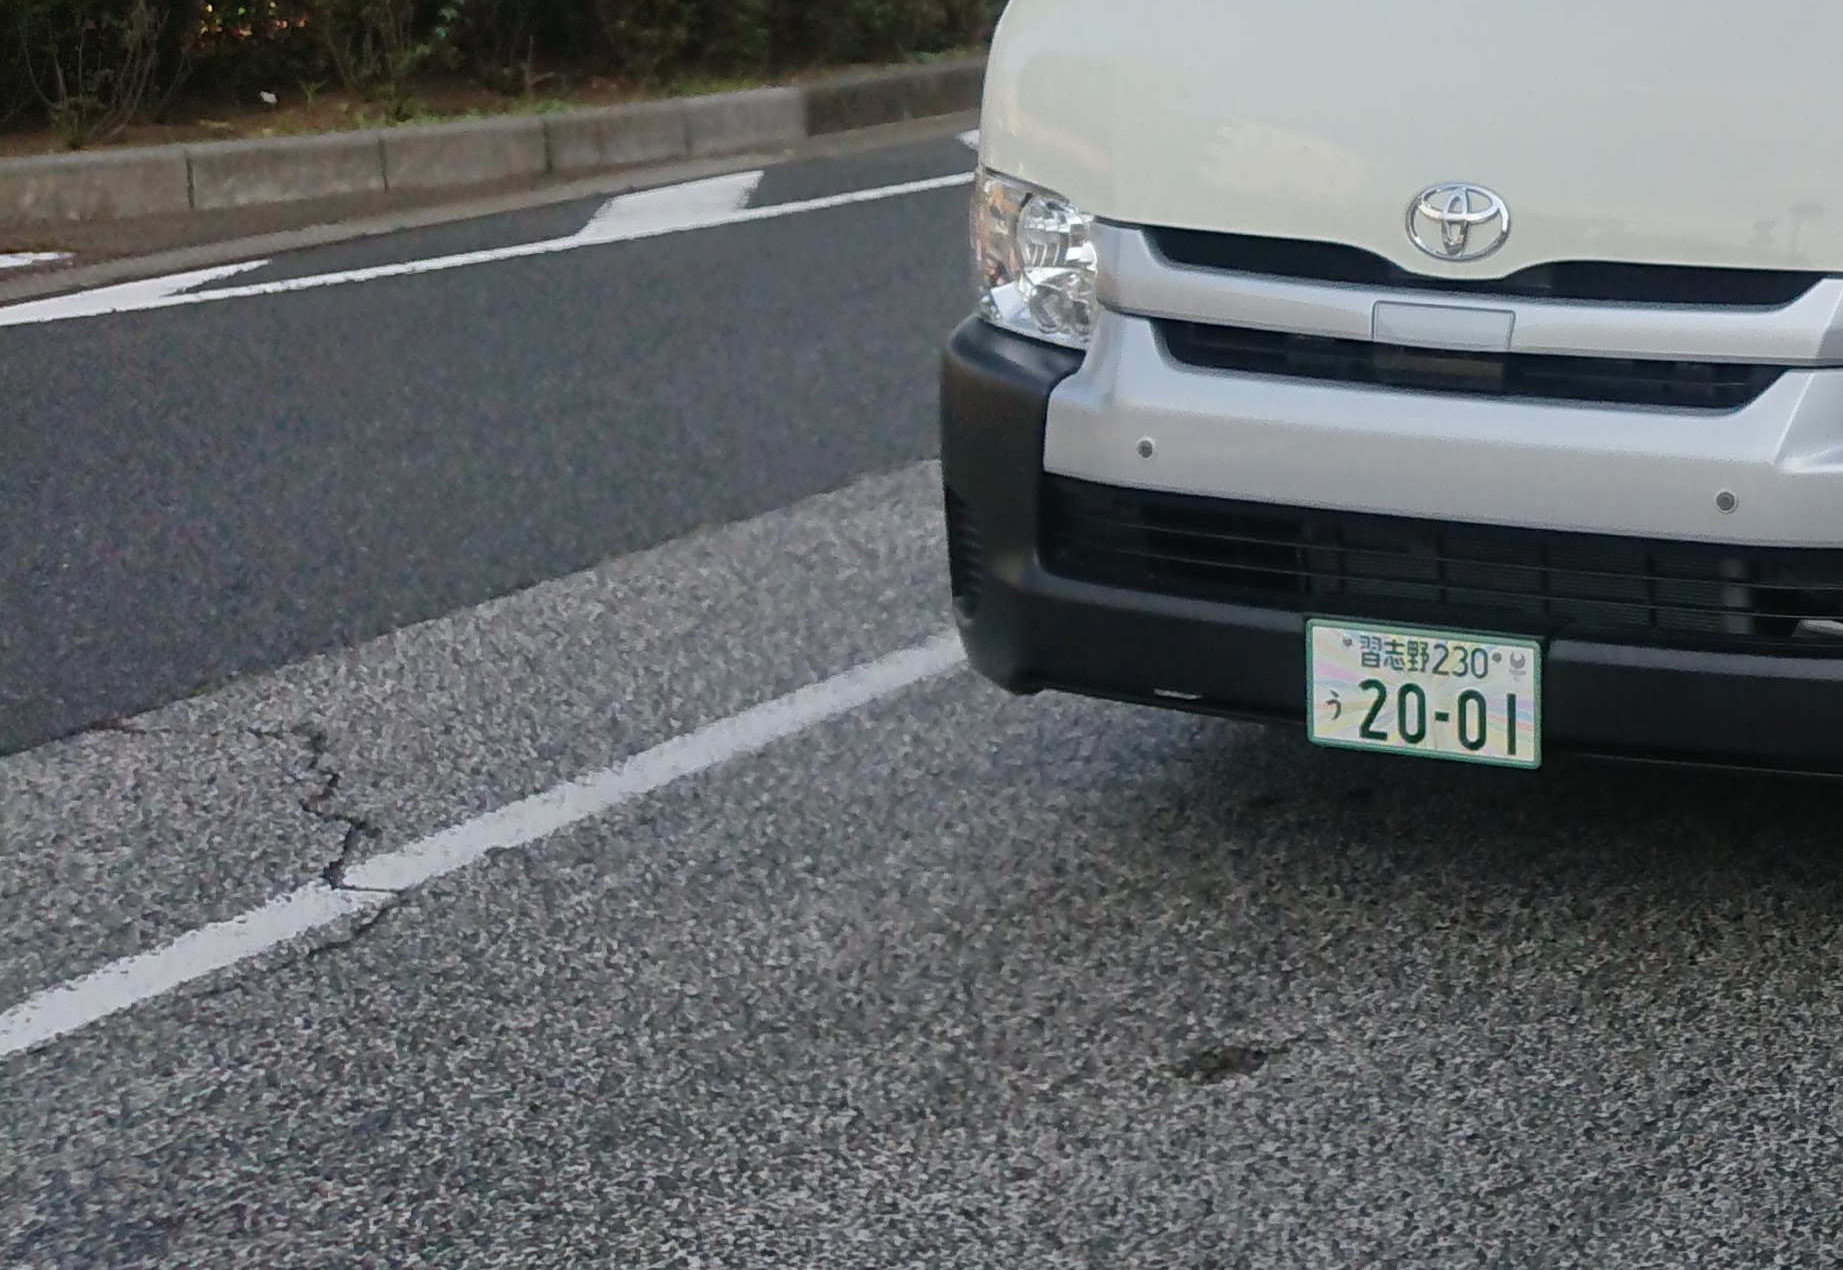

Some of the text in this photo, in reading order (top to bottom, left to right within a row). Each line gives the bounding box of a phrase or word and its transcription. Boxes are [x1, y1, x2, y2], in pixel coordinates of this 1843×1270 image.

[1358, 634, 1489, 680] 習志野230
[1326, 678, 1517, 756] う 20-01
